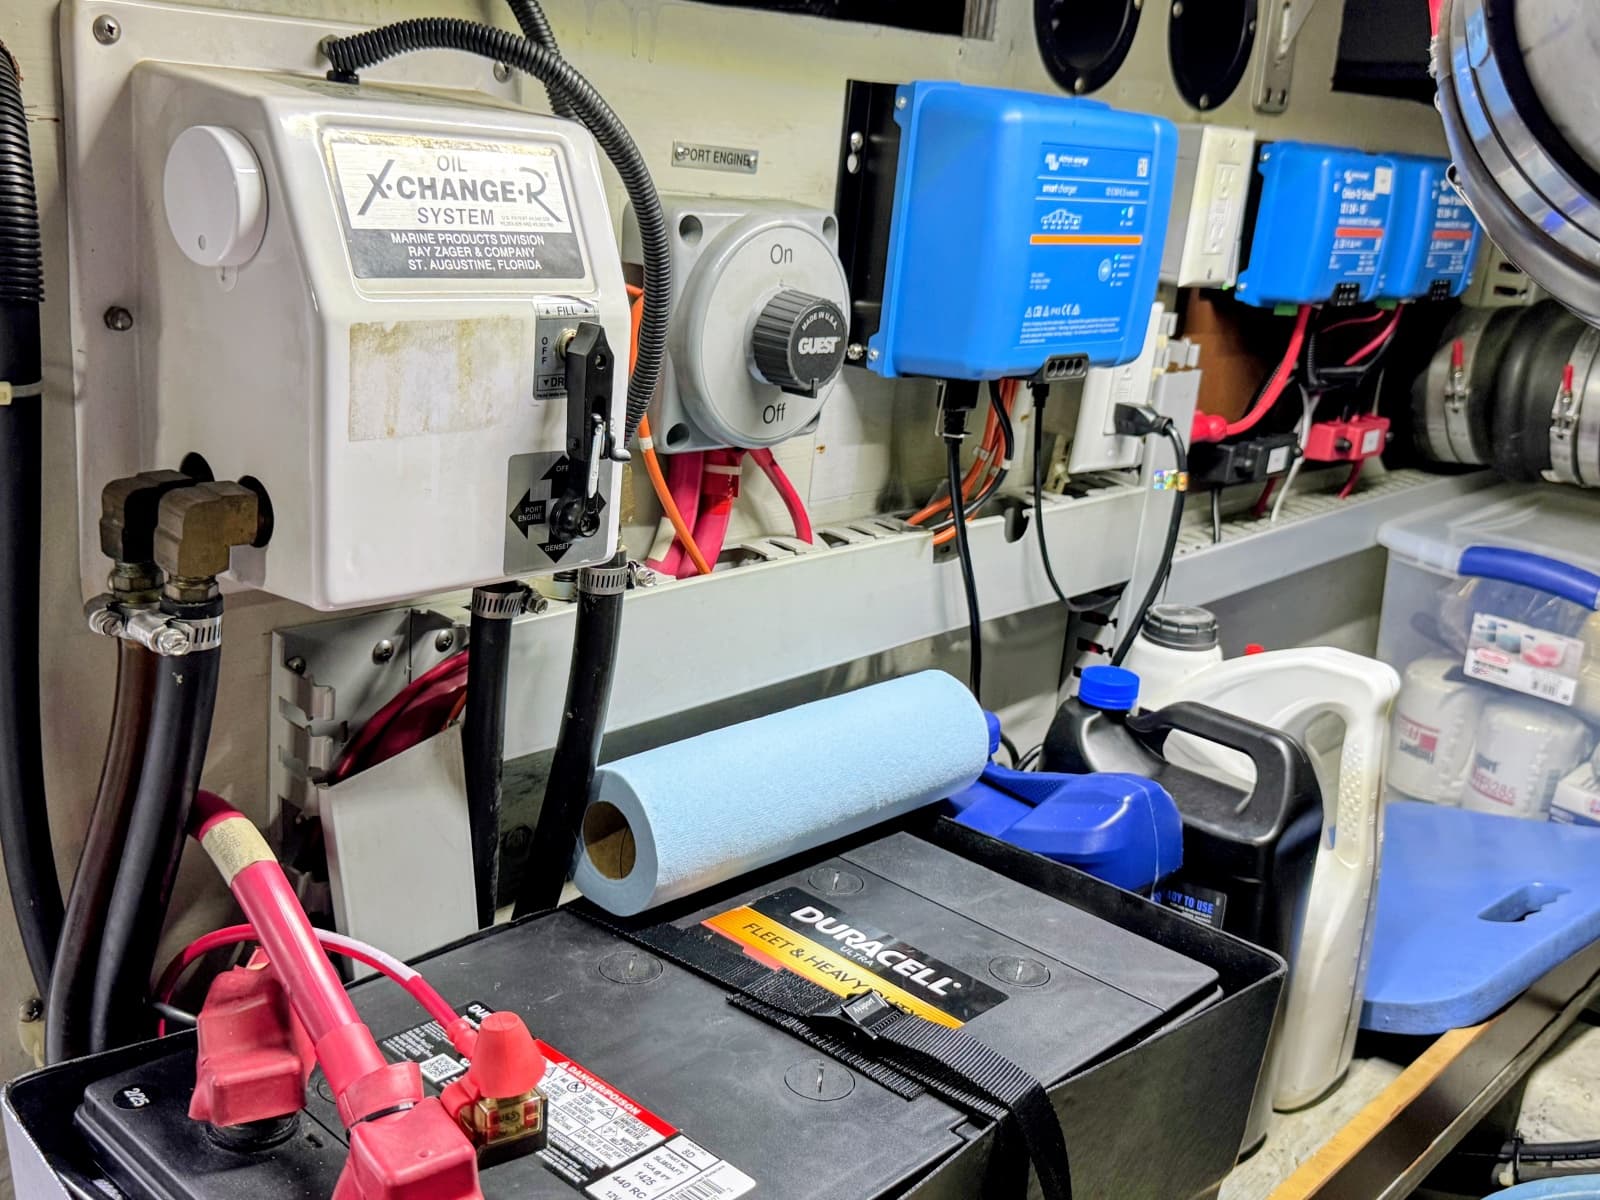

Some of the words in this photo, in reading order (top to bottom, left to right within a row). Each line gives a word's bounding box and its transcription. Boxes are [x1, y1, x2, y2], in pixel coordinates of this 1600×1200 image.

[436, 154, 468, 173] OIL
[682, 147, 711, 162] PORT
[713, 150, 752, 168] ENGINE
[417, 206, 495, 226] SYSTEM
[390, 232, 436, 244] MARINE
[438, 233, 498, 245] PRODUCTS
[500, 234, 545, 246] DIVISION
[408, 246, 432, 257] RAY
[435, 246, 473, 257] ZAGER
[475, 247, 482, 258] &
[484, 247, 536, 258] COMPANY
[770, 243, 793, 265] On
[408, 259, 427, 270] ST.
[430, 259, 496, 272] AUGUSTINE,
[498, 260, 543, 271] FLORIDA
[557, 306, 578, 316] FILL
[801, 312, 818, 331] MADE
[798, 336, 840, 355] GUEST
[762, 403, 786, 425] Off
[518, 513, 541, 522] ENGINE
[544, 543, 569, 552] GENSET
[1196, 900, 1215, 914] USE
[742, 922, 795, 949] FLEET
[790, 948, 805, 958] &
[804, 956, 870, 990] HEAVY
[790, 906, 949, 996] DURACELL
[839, 946, 874, 967] ULTRA
[568, 1066, 641, 1115] DANGER/POISON
[612, 1175, 631, 1189] 440
[629, 1186, 647, 1199] RC
[635, 1171, 657, 1186] 1425
